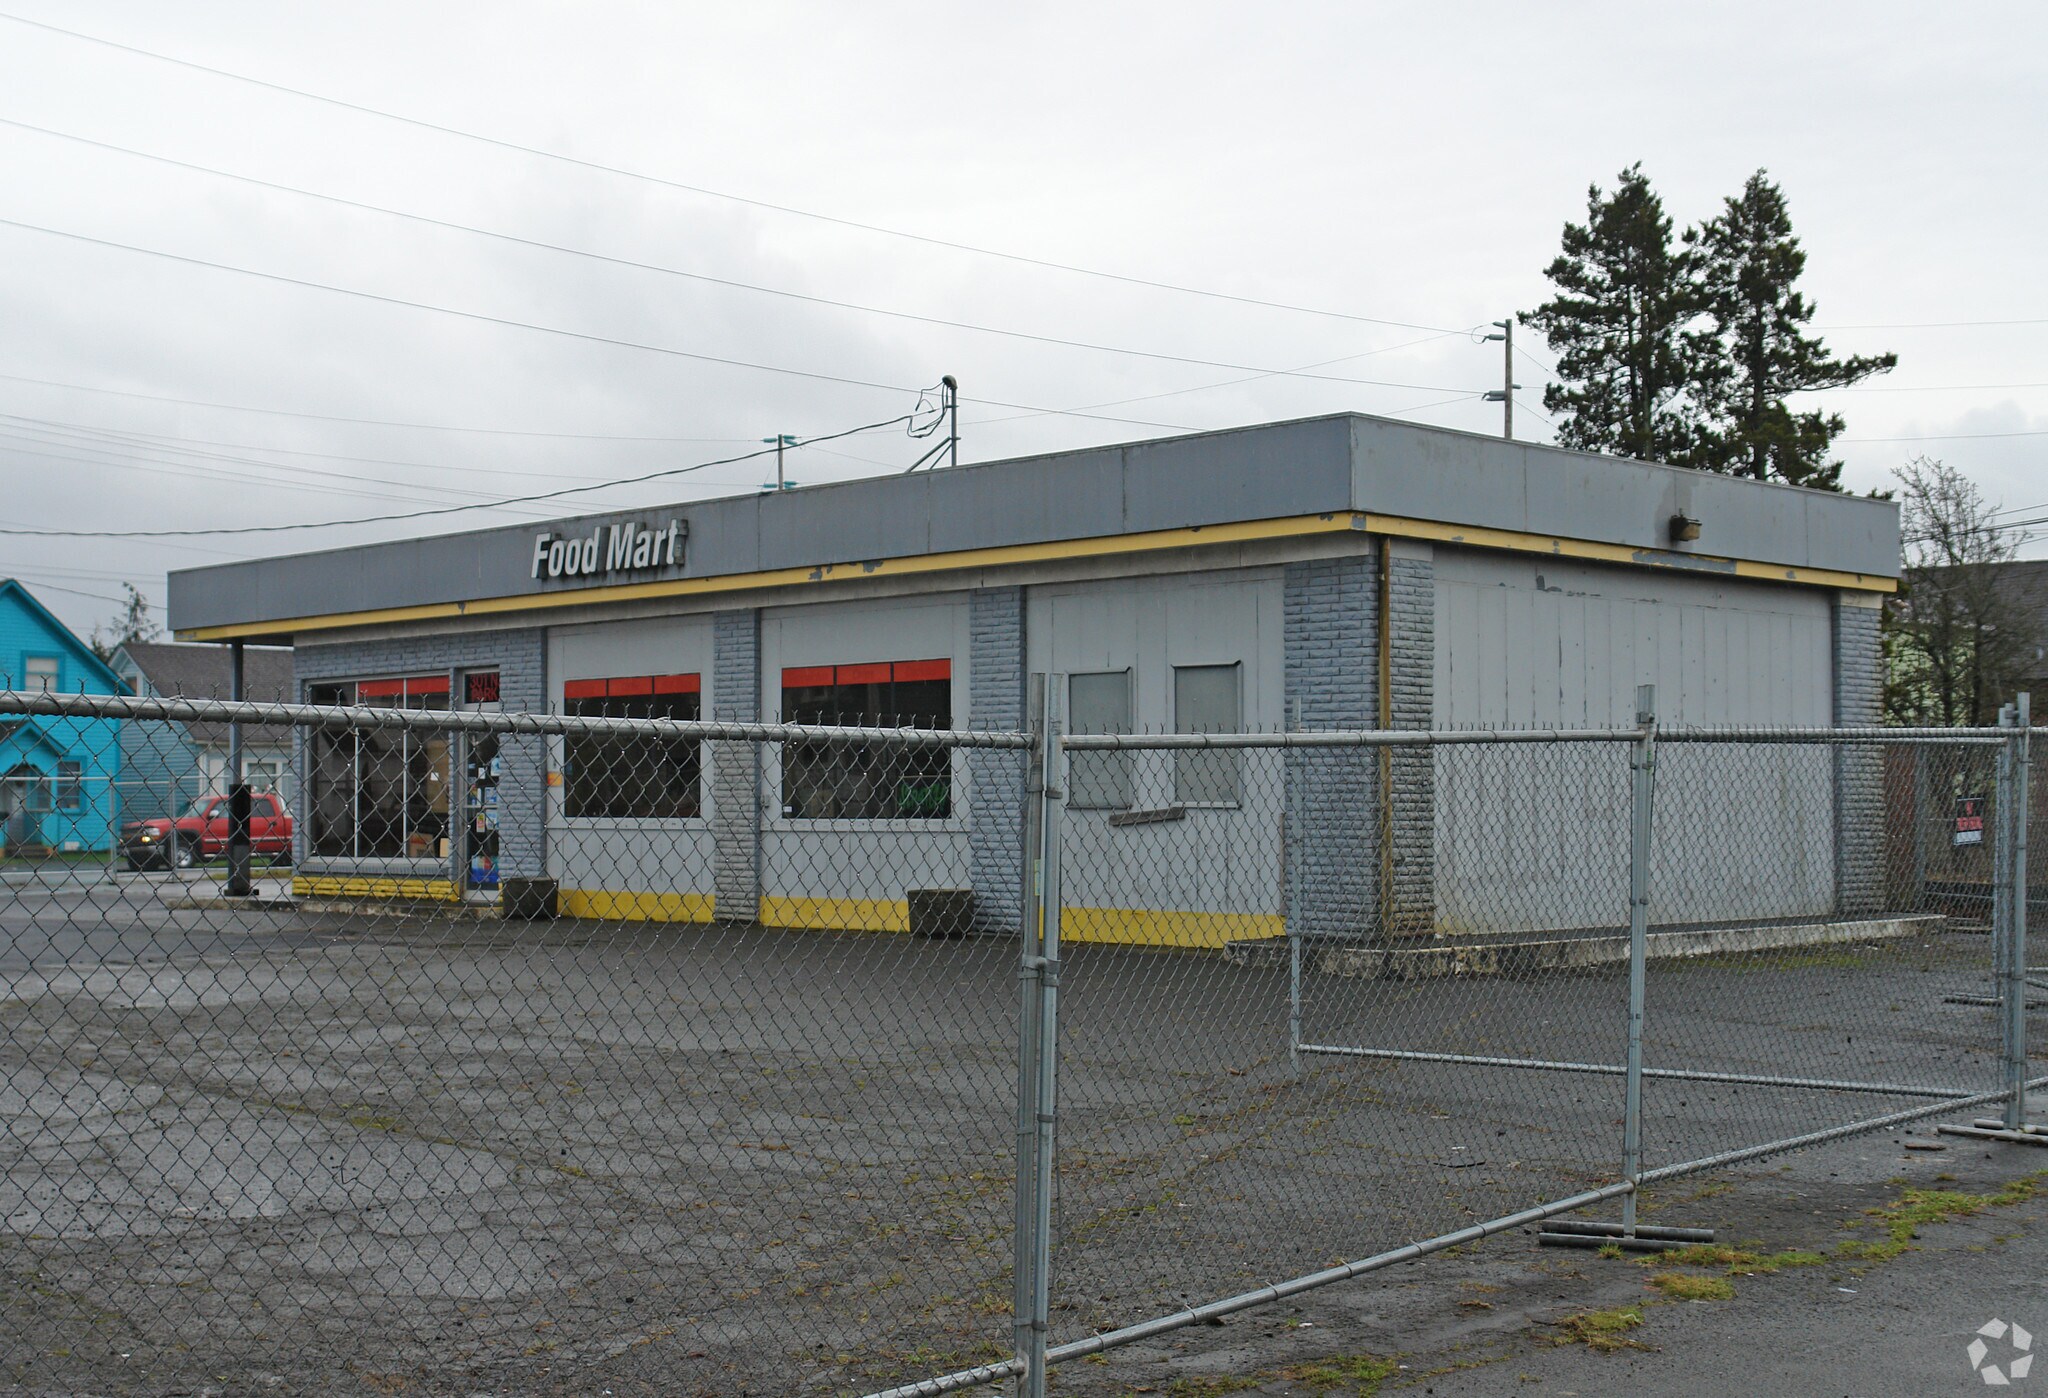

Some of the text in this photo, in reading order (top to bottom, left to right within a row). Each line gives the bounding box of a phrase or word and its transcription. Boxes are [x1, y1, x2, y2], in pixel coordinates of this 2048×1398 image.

[531, 518, 679, 579] Food Mart
[470, 686, 498, 702] PARK
